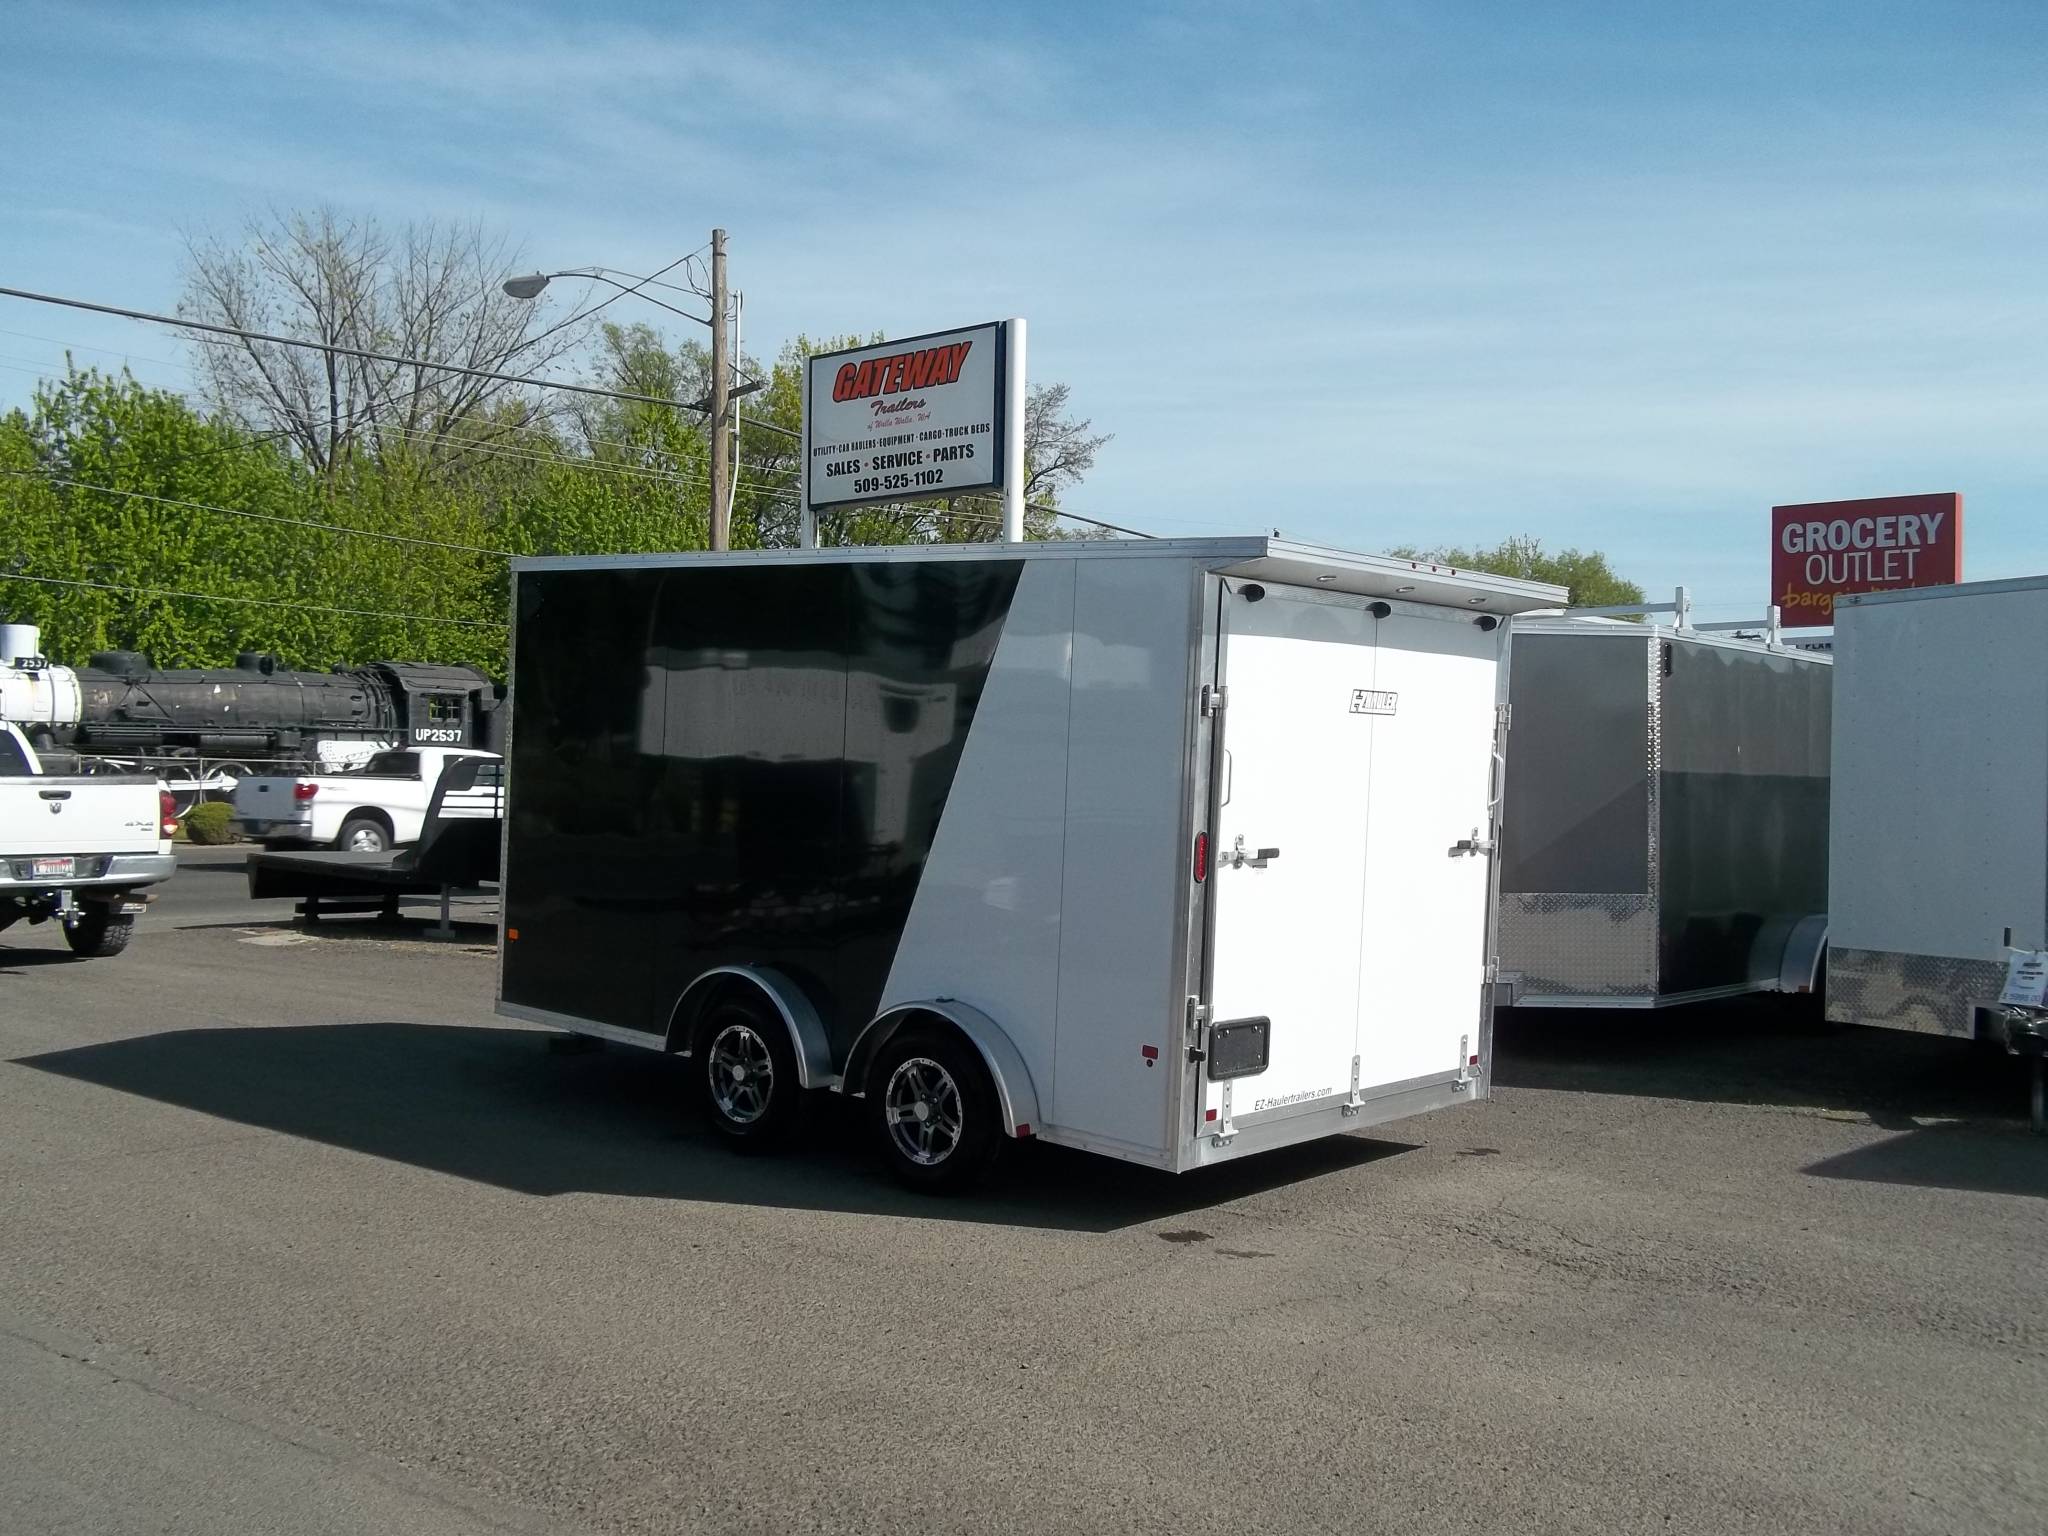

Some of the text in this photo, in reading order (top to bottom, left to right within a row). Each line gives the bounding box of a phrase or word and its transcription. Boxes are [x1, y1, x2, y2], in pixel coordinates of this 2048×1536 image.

[833, 341, 972, 403] GATEWAY
[871, 397, 926, 416] Trailers
[851, 439, 877, 452] HAULERS
[879, 433, 915, 447] EQUIPMENT
[971, 423, 991, 434] BEDS
[826, 443, 975, 477] SALES SERVICE PARTS
[854, 468, 944, 494] 509-525-1102
[1782, 513, 1944, 554] GROCERY
[1805, 549, 1921, 585] OUTLET
[22, 659, 49, 668] 2537
[415, 728, 462, 742] UP2537
